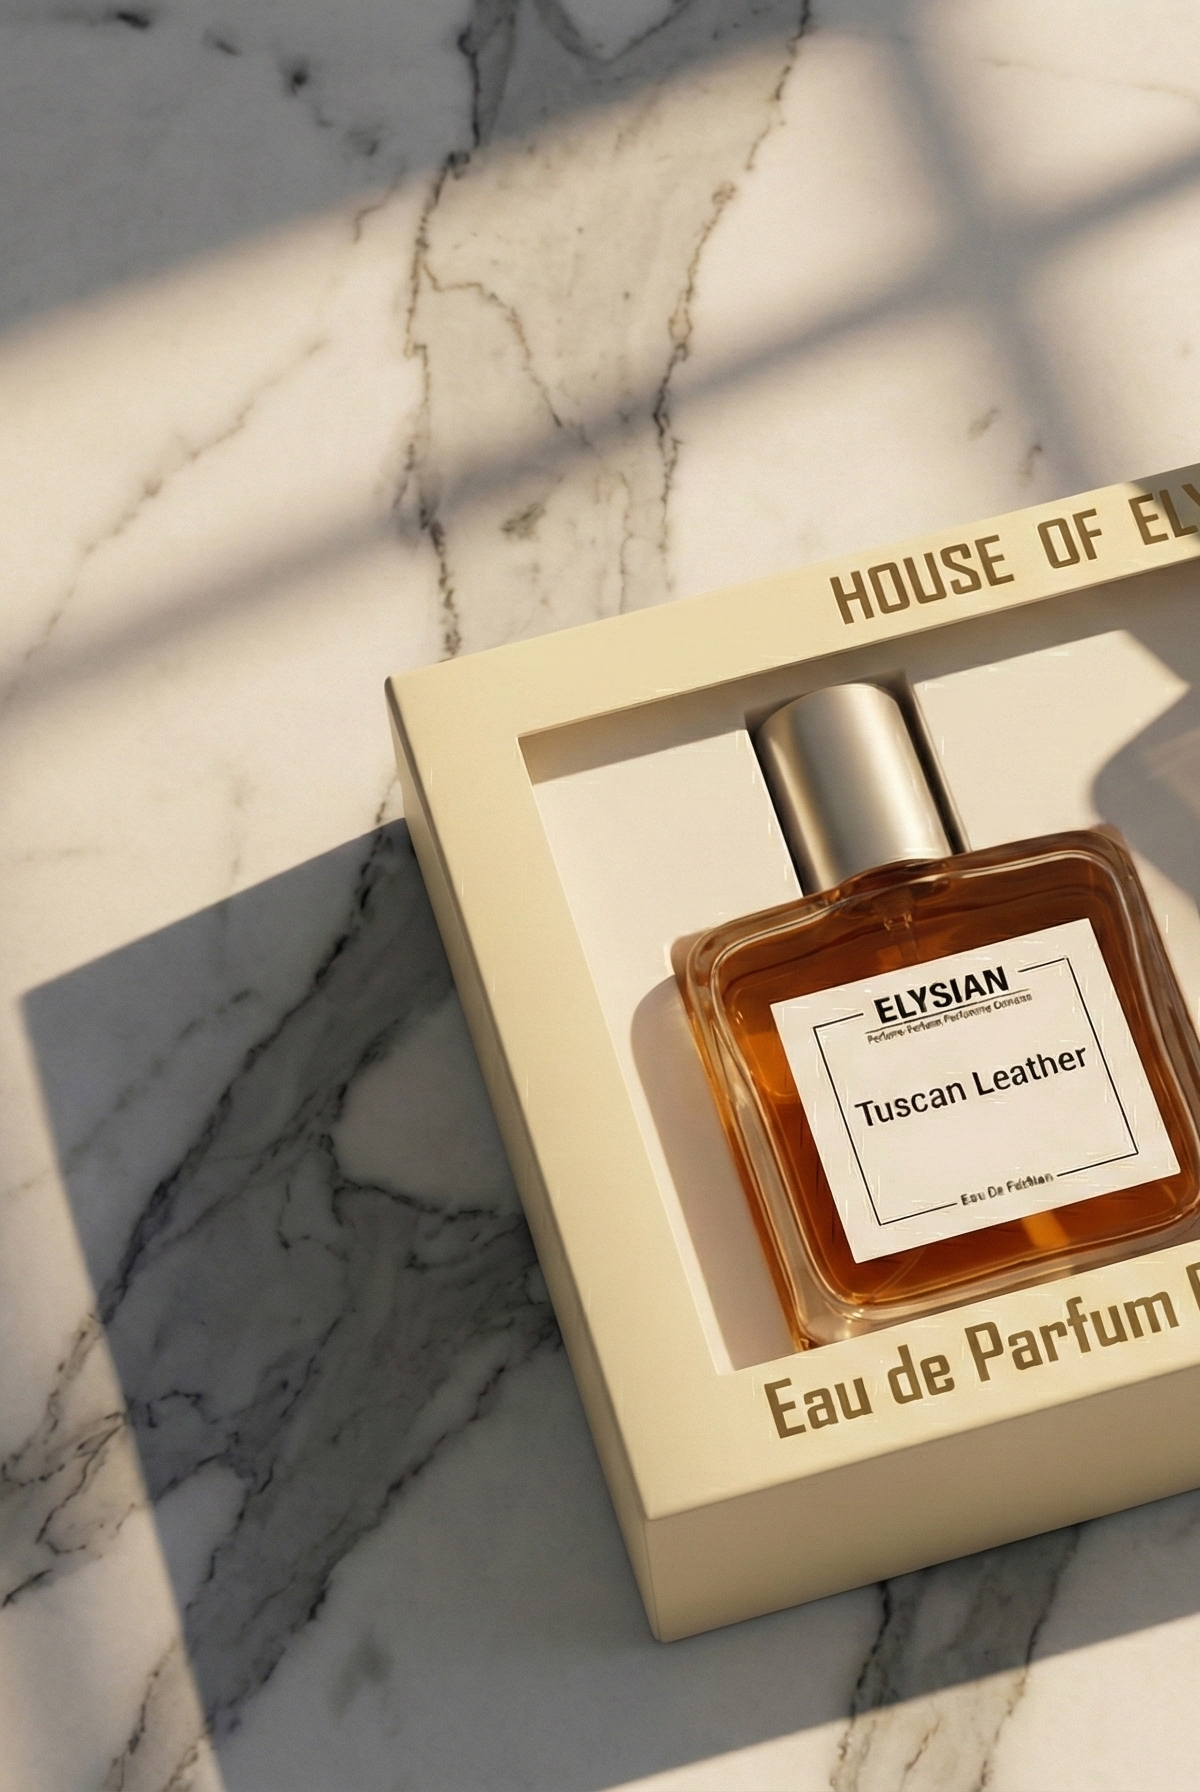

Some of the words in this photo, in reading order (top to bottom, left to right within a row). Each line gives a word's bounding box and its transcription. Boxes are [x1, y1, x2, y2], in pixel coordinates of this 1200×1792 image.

[829, 534, 1015, 625] HOUSE
[1037, 508, 1102, 568] OF
[874, 966, 1009, 1024] ELYSIAN
[854, 1082, 967, 1127] Tuscan
[971, 1047, 1087, 1096] Leather
[763, 1377, 874, 1439] Eau
[887, 1344, 956, 1404] de
[964, 1296, 1179, 1382] Parfum
